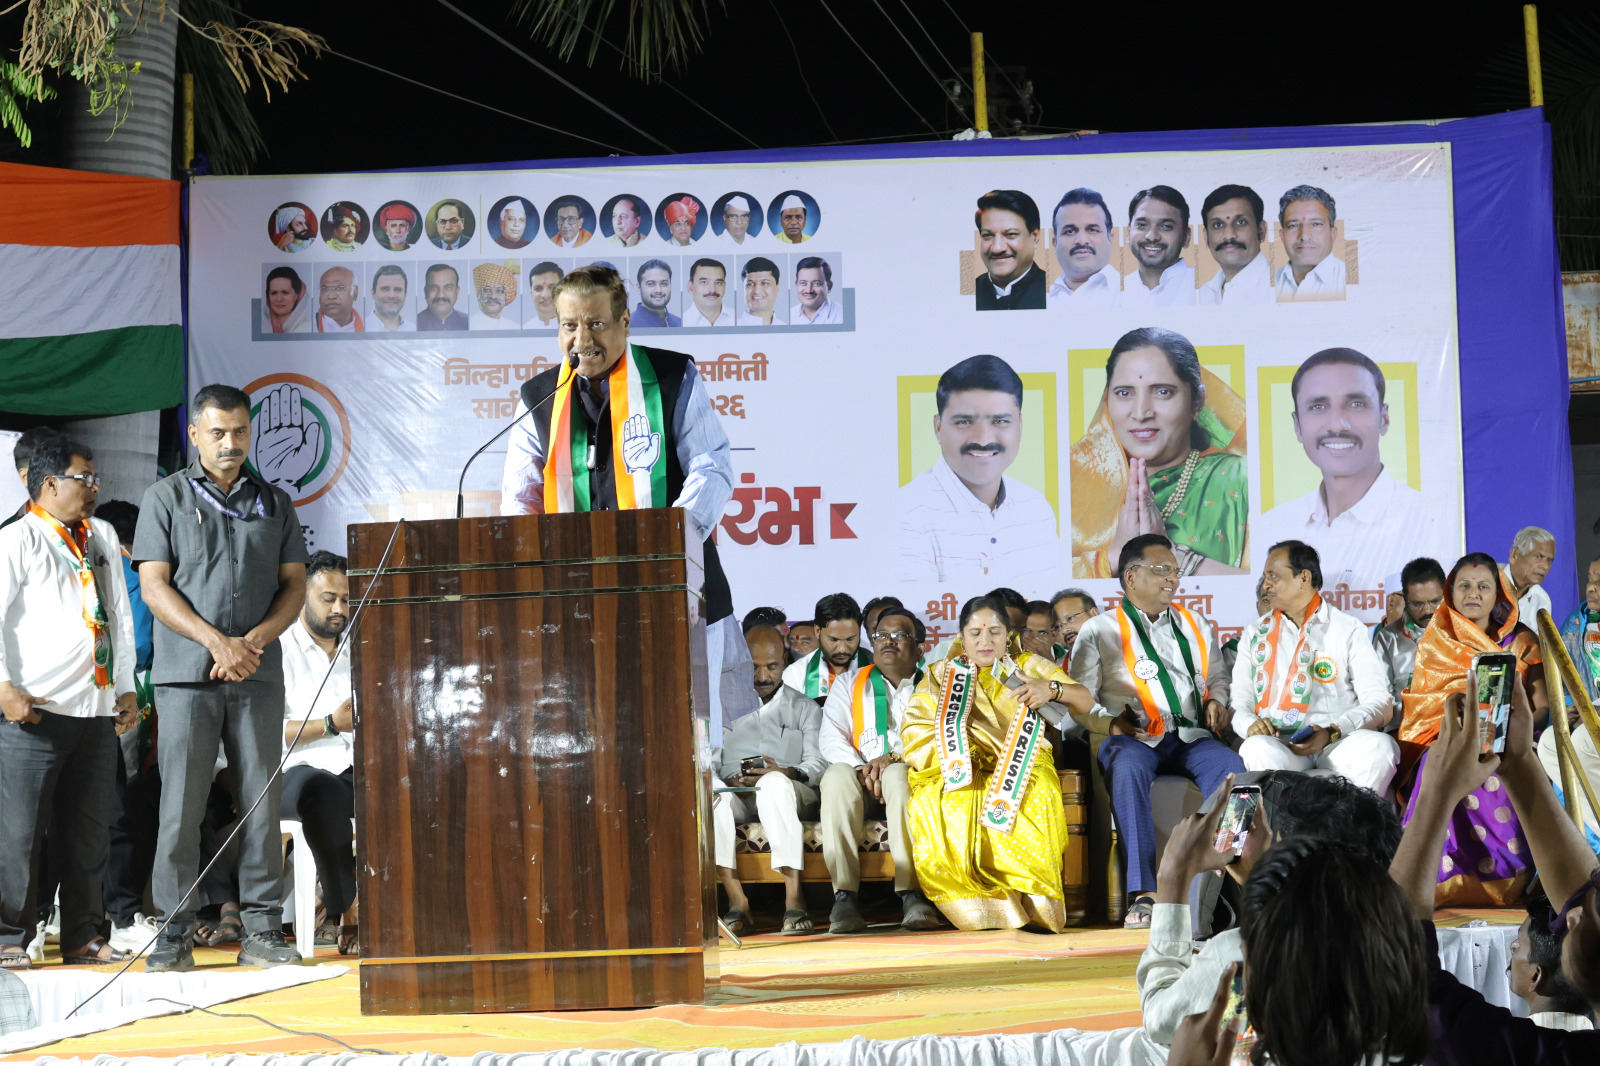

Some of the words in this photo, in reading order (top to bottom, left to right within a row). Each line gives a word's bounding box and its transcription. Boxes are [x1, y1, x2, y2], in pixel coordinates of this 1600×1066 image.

[442, 358, 511, 388] जिल्हा
[696, 352, 769, 382] समिती
[946, 673, 965, 752] CONGRESS
[1003, 708, 1036, 792] NGRESS
